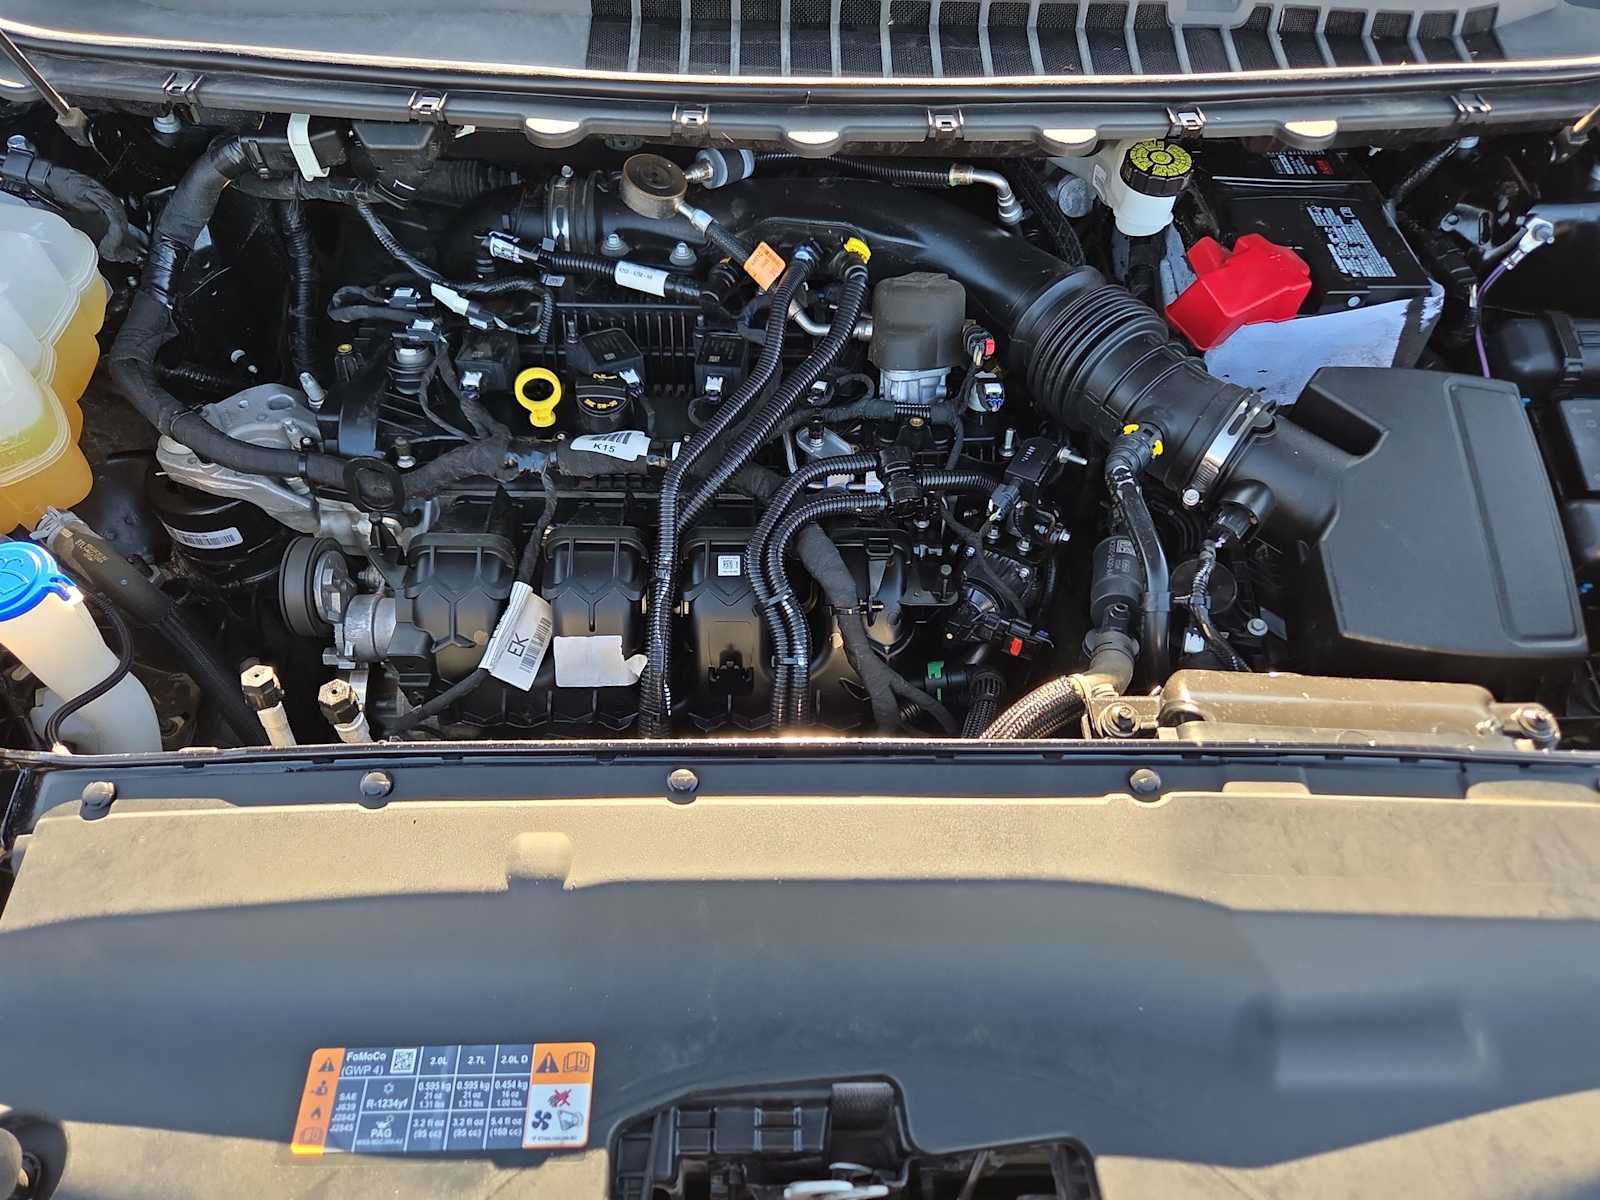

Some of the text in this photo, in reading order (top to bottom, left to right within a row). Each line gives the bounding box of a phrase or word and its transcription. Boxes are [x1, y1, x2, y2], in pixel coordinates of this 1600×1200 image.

[593, 442, 616, 453] K15
[507, 632, 529, 657] EK
[346, 1051, 386, 1062] FoMoCo
[429, 1056, 448, 1066] 2.0L
[466, 1055, 486, 1065] 2.7L
[500, 1055, 529, 1065] 2.0L D
[341, 1065, 385, 1077] (GWP 4)
[441, 1081, 452, 1092] kg
[479, 1081, 490, 1092] kg
[517, 1080, 529, 1092] kg
[366, 1098, 409, 1110] R-1234yf
[370, 1128, 393, 1138] PAG
